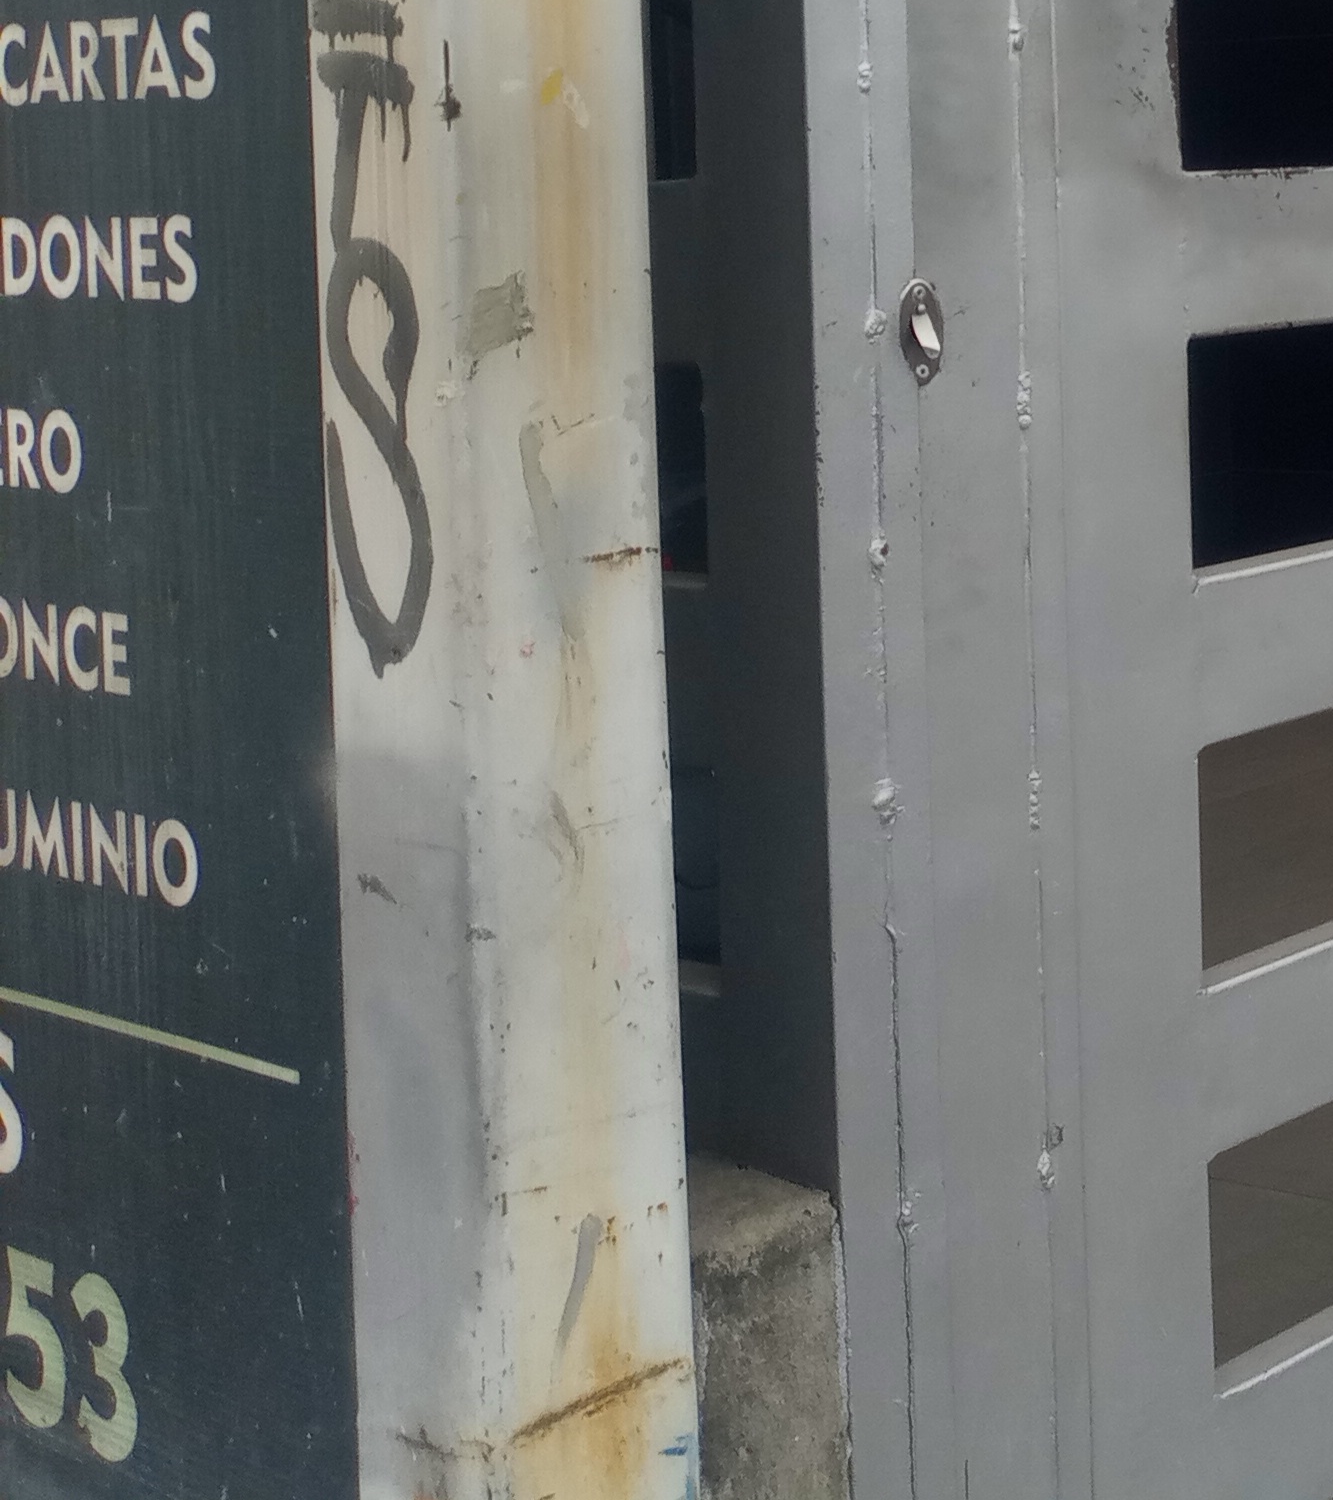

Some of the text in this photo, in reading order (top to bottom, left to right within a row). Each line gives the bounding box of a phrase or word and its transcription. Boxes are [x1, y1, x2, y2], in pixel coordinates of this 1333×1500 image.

[0, 10, 218, 104] CARTAS
[2, 214, 199, 304] DONES
[0, 409, 83, 494] RO
[3, 1244, 140, 1464] 53
